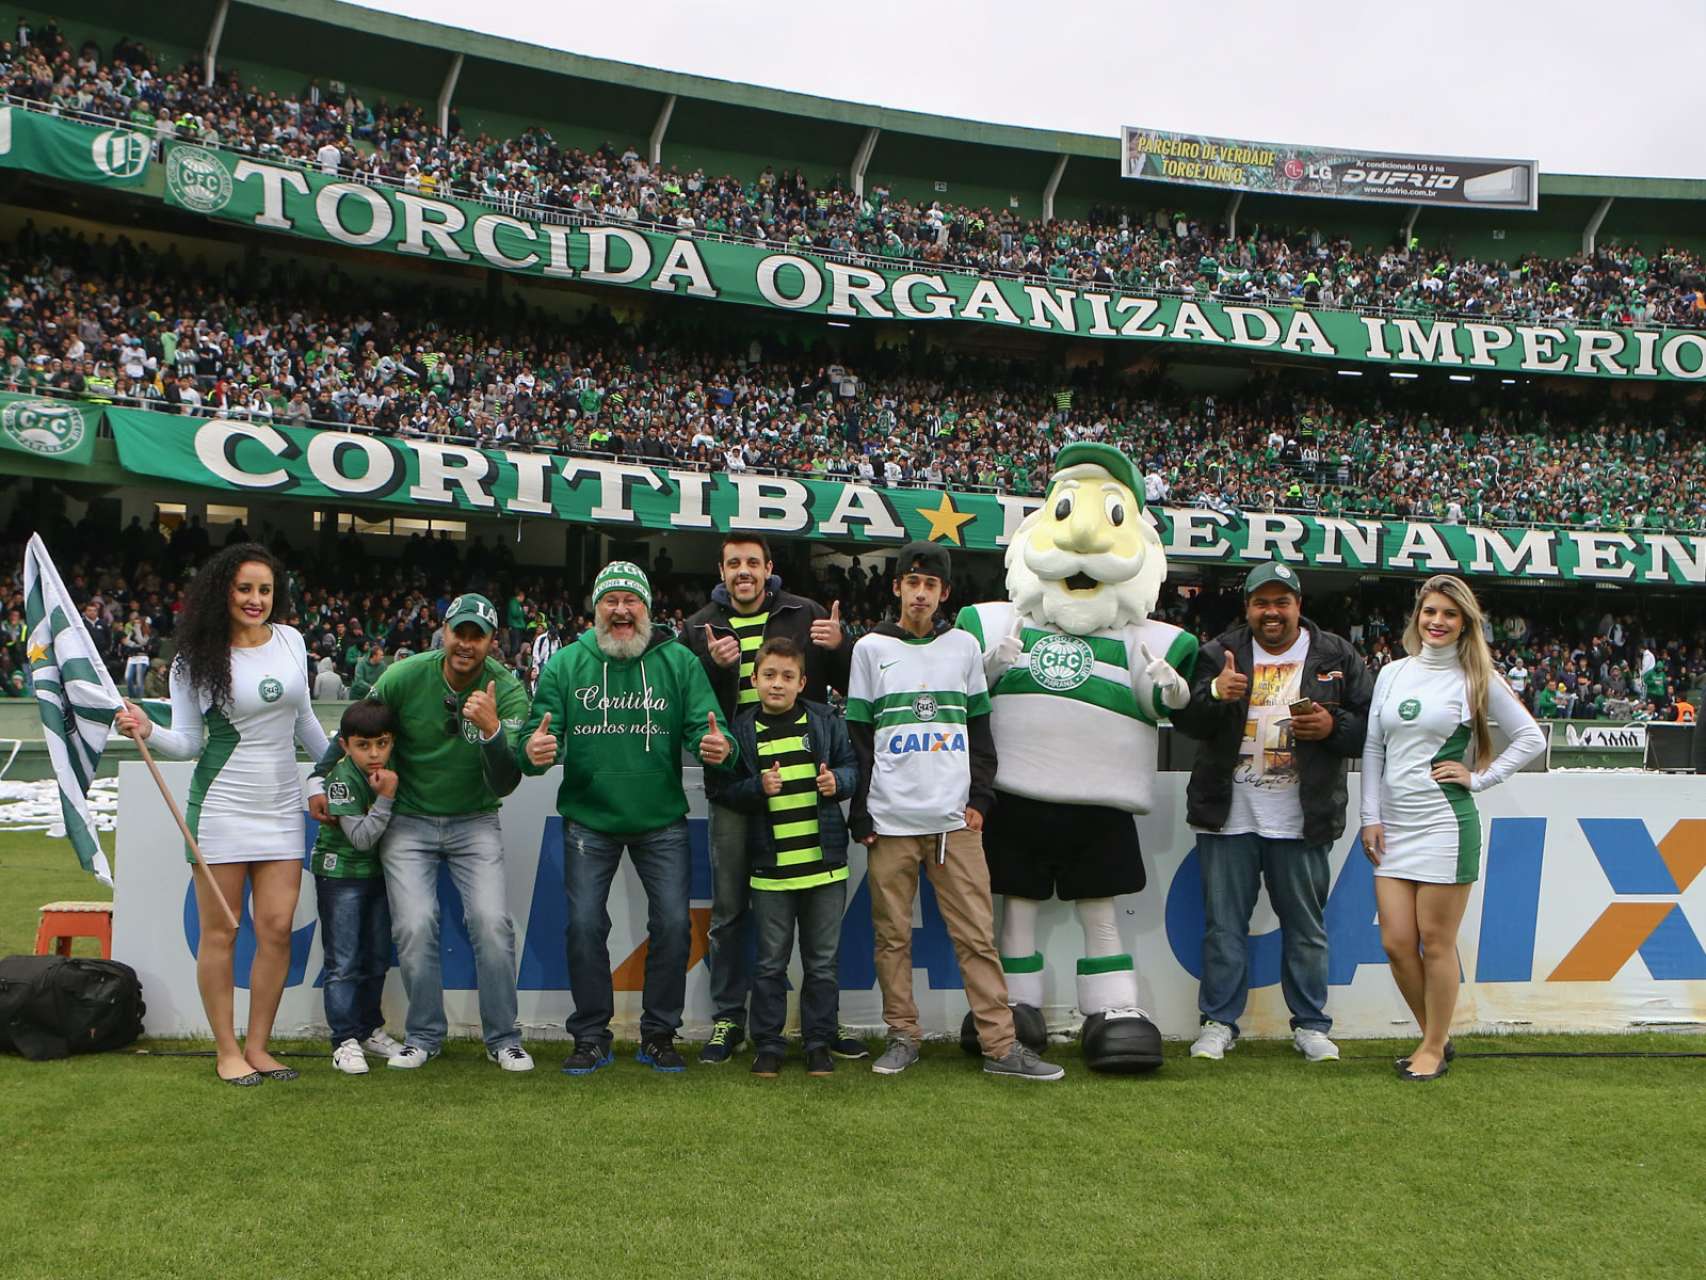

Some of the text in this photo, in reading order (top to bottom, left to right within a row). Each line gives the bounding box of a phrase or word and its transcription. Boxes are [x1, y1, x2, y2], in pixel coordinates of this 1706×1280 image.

[1138, 136, 1276, 167] PARCEIRO DE VERDADE
[1162, 159, 1243, 184] TORCE JUNTO
[1309, 165, 1332, 180] LG
[1366, 161, 1415, 171] condicionado
[1364, 187, 1437, 197] www.dufrio.com.br
[234, 159, 719, 298] TORCIDA
[756, 254, 1338, 356] ORGANIZADA
[1361, 317, 1706, 379] IMPERIO
[20, 411, 67, 434] CFC
[194, 419, 905, 539] CORITIBA
[996, 496, 1706, 583] ERNAMEN
[1042, 653, 1080, 668] CFC
[575, 685, 668, 711] Coritiba
[573, 723, 625, 736] somos
[889, 733, 966, 754] CAIXA
